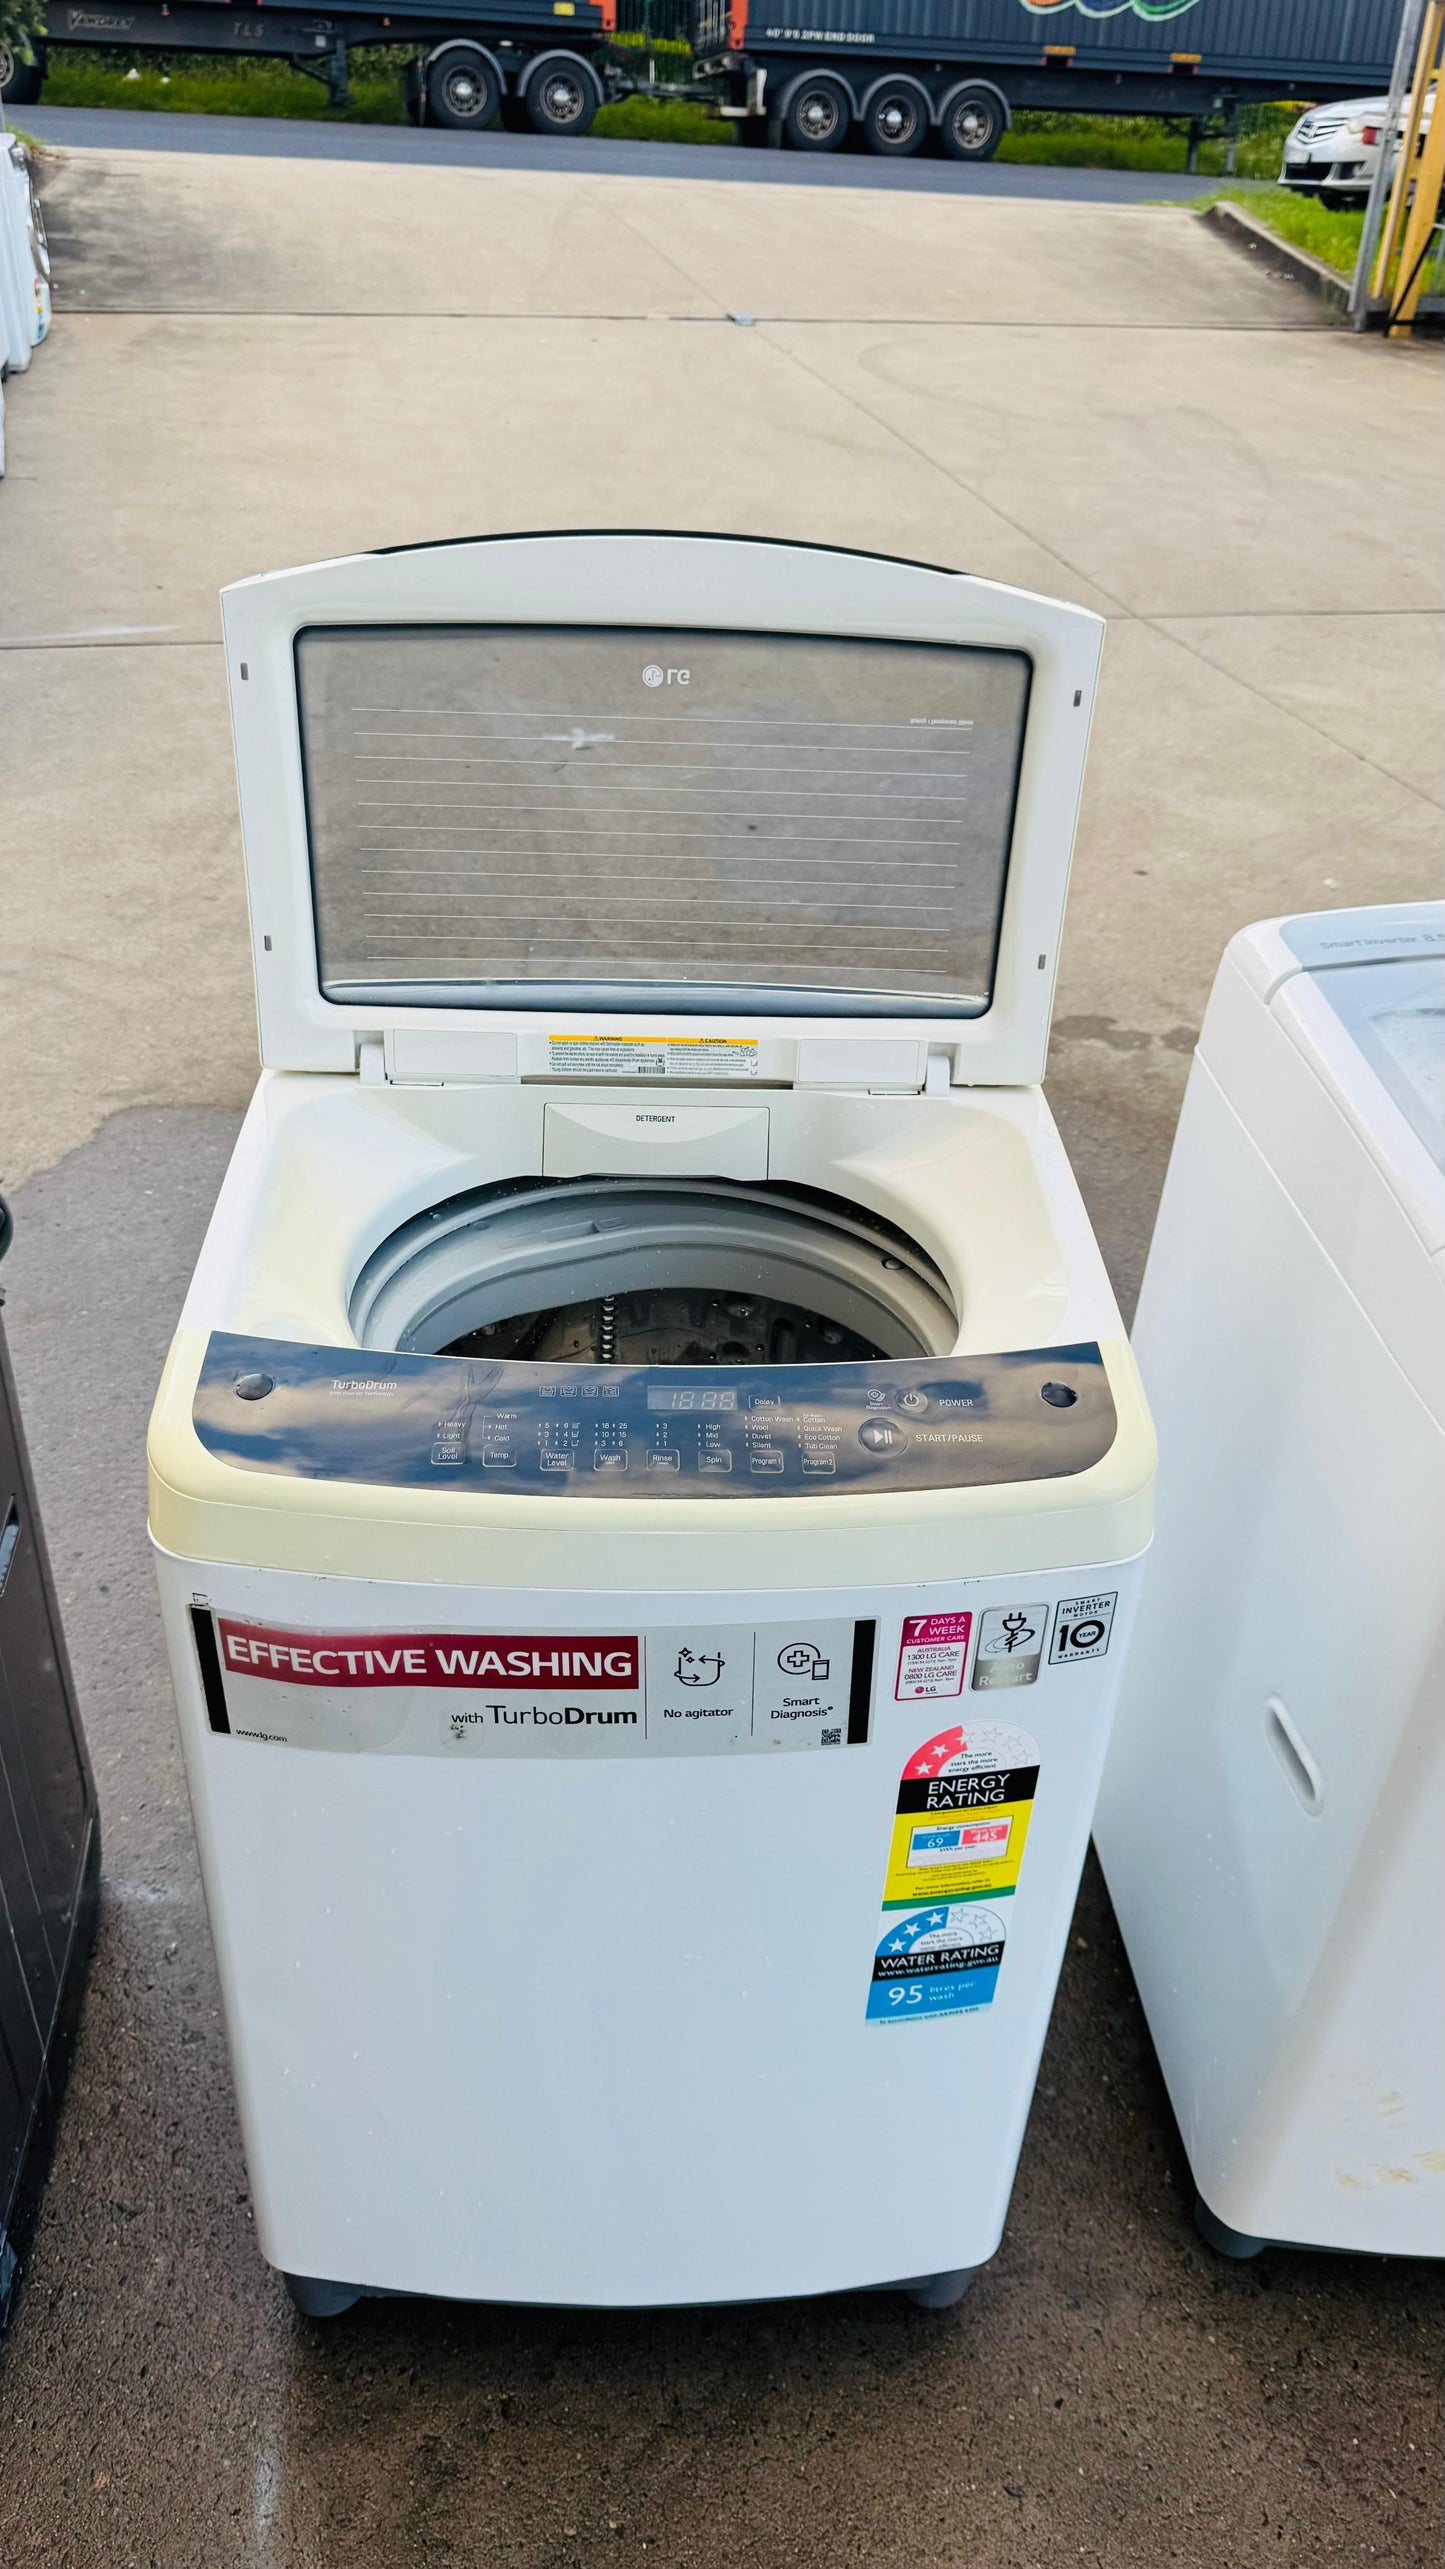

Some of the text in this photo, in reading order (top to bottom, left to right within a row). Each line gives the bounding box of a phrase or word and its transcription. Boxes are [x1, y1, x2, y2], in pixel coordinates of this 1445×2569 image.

[1320, 939, 1361, 949] Smart
[1365, 936, 1417, 946] Inverter
[331, 1380, 397, 1390] TurboDrum
[754, 1398, 775, 1406] Delay
[939, 1399, 974, 1407] POWER
[705, 1423, 721, 1431] High
[442, 1432, 461, 1440] Light
[915, 1434, 984, 1442] START/PAUSE
[547, 1459, 567, 1467] Level
[706, 1456, 723, 1464] Spin
[1075, 1597, 1101, 1605] SMART
[1062, 1600, 1111, 1615] INVERTER
[930, 1616, 956, 1625] DAYS
[909, 1619, 928, 1637] 7
[929, 1625, 965, 1635] WEEK
[1059, 1619, 1106, 1651] 10
[1078, 1630, 1097, 1638] YEAR
[906, 1636, 946, 1644] CUSTOMER
[226, 1634, 427, 1675] EFFECTIVE
[938, 1650, 960, 1658] CARE
[1058, 1648, 1100, 1659] WARRANTY
[434, 1649, 633, 1677] WASHING
[782, 1697, 821, 1707] Smart
[451, 1705, 638, 1725] with TurboDrum
[663, 1708, 734, 1720] No agitator
[236, 1728, 288, 1743] www.lg.com
[928, 1773, 1011, 1795] ENERGY
[926, 1788, 1006, 1810] RATING
[972, 1831, 998, 1842] 445
[927, 1837, 944, 1848] 69
[880, 1955, 935, 1969] WATER
[940, 1944, 1000, 1963] RATING
[877, 1956, 999, 1977] www.waterrating.gov.au
[957, 1981, 977, 1991] per
[888, 1984, 924, 2006] 95
[928, 1993, 955, 2001] wash
